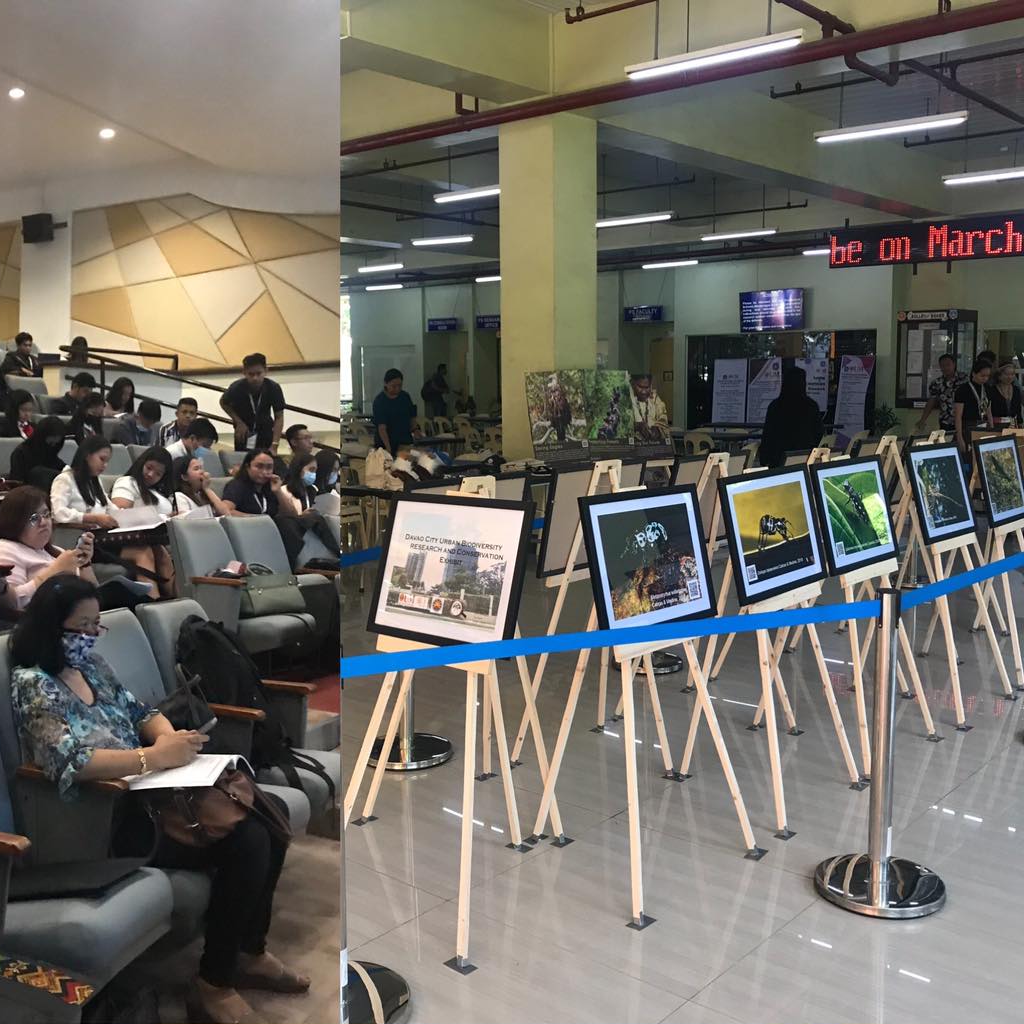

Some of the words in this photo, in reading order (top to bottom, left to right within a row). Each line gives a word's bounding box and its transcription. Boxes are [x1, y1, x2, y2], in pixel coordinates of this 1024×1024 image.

[831, 235, 863, 265] be
[879, 236, 911, 261] on
[928, 221, 1023, 258] March
[410, 543, 442, 553] RESEARCH
